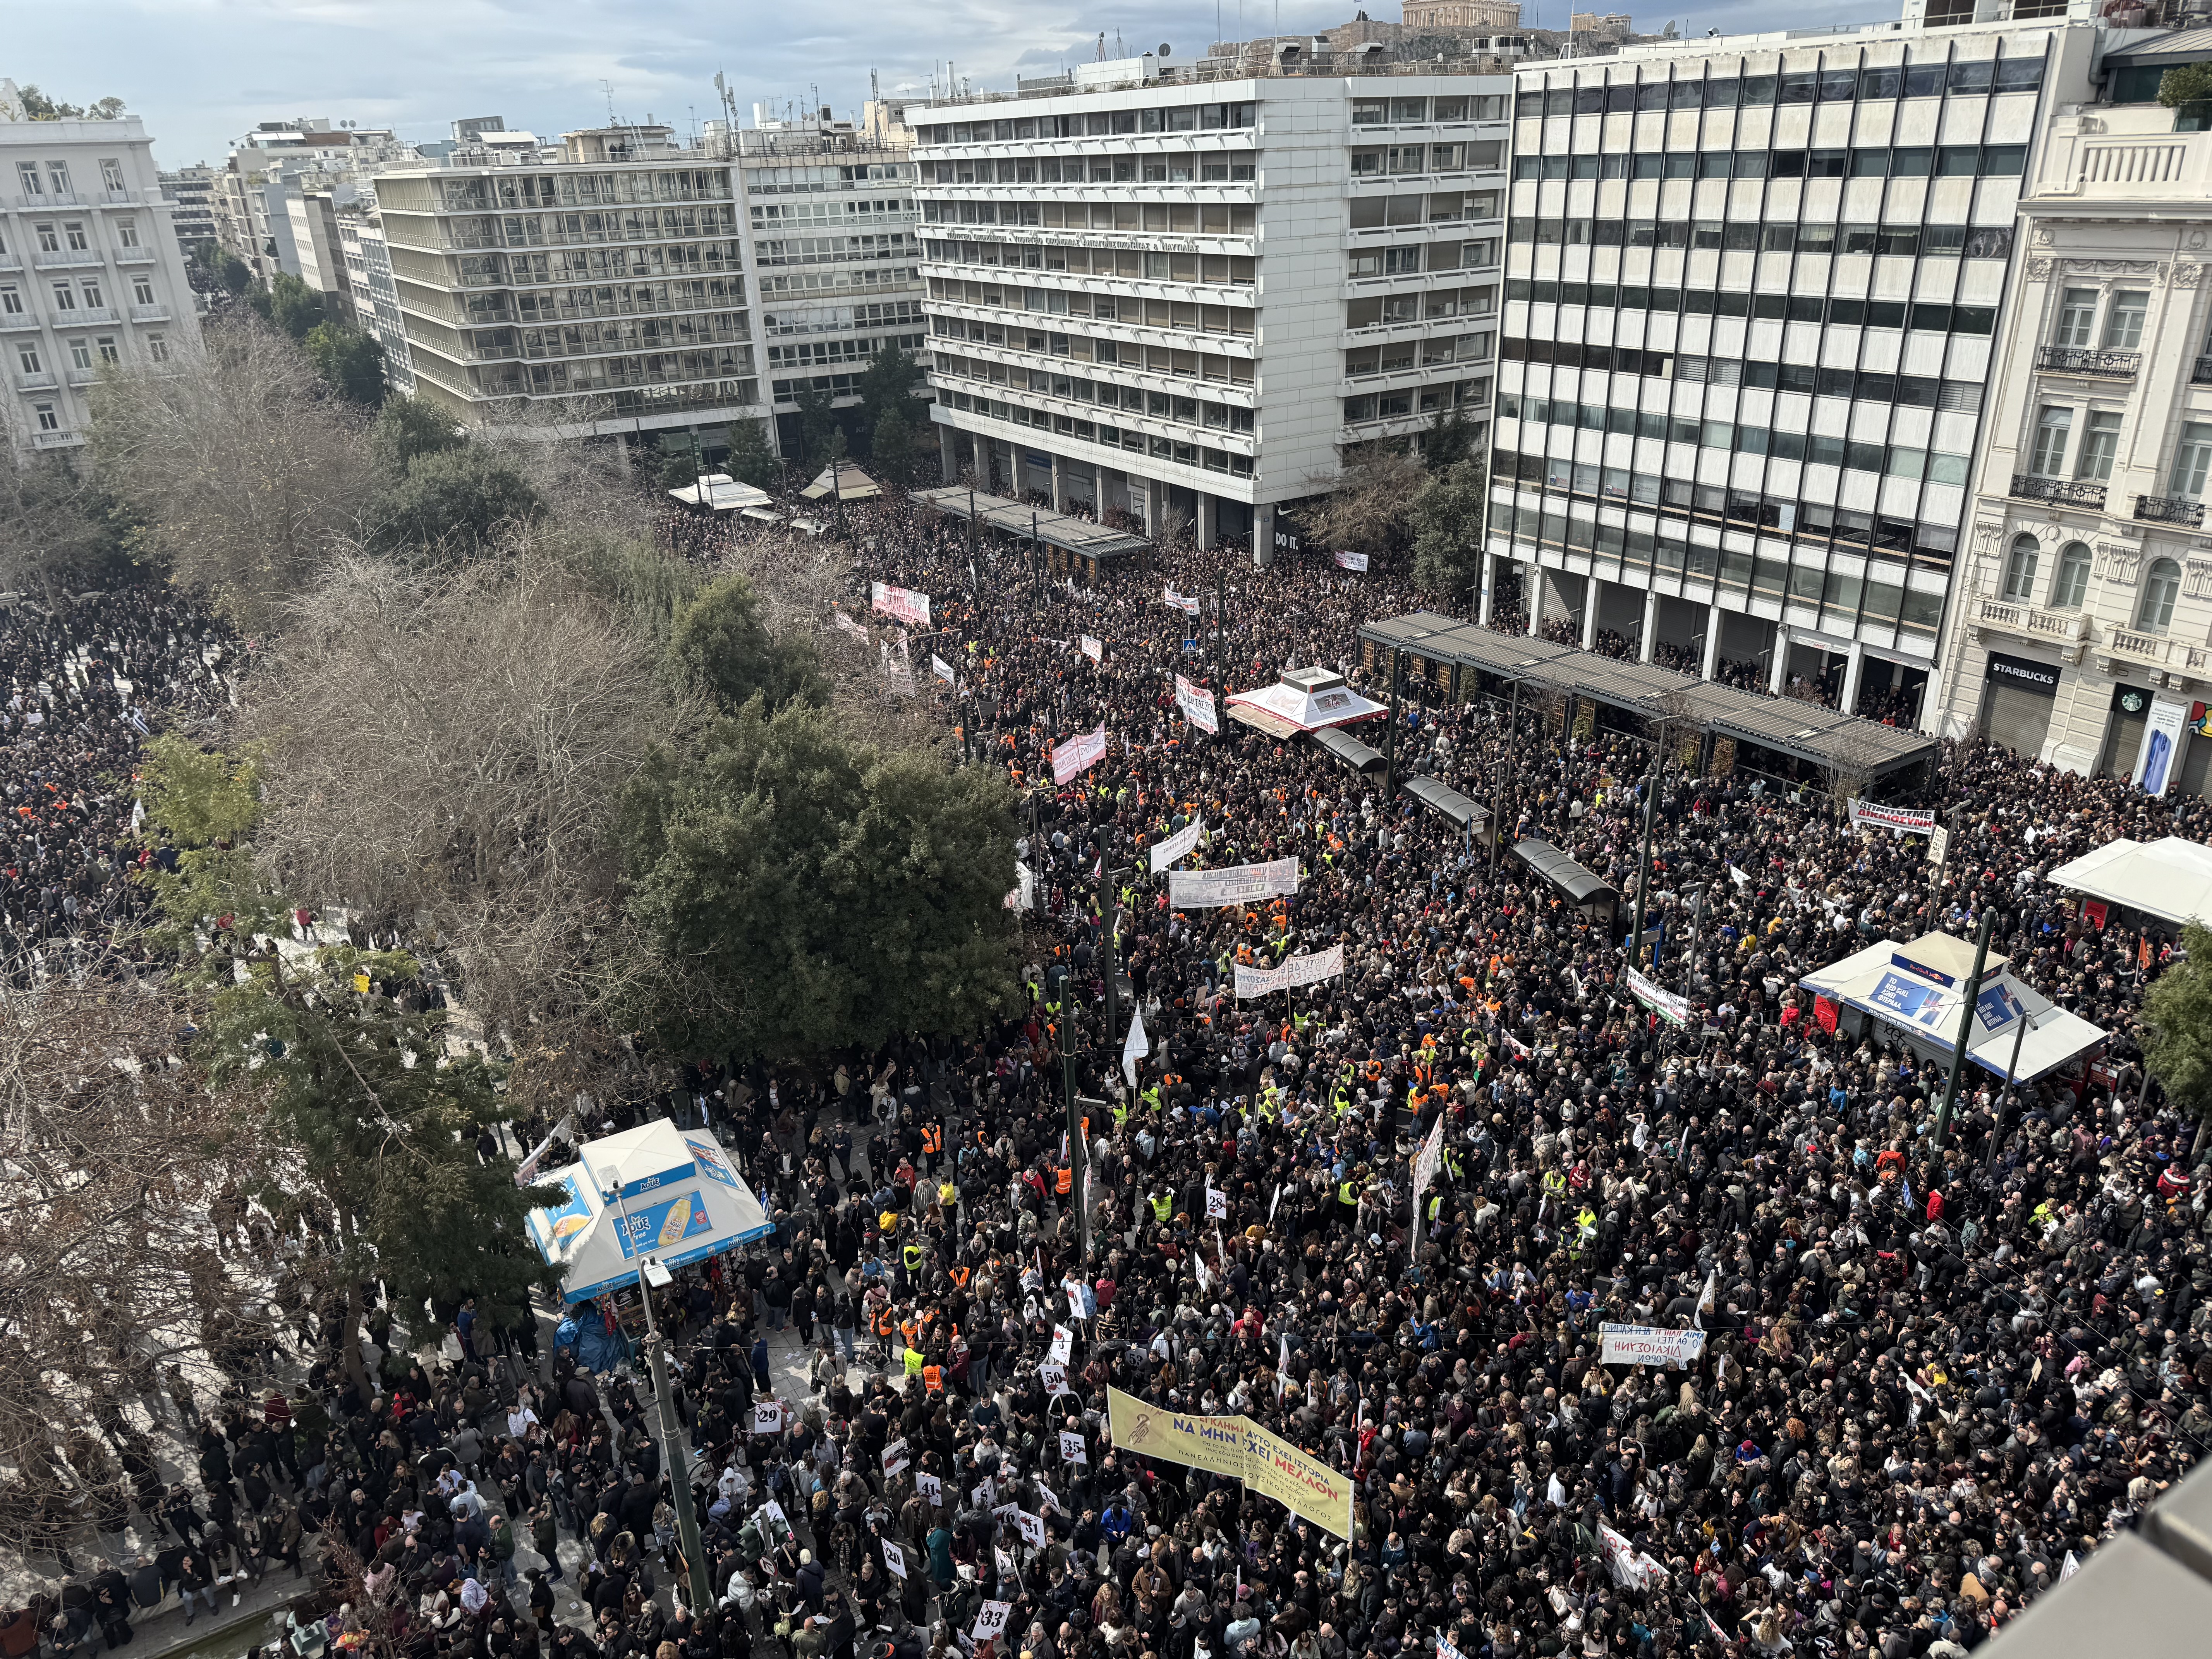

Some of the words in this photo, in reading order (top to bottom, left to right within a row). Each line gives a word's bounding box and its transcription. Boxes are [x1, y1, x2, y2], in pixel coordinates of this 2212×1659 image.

[1014, 236, 1043, 244] ΥΠΟΥΡΓΕΙΟ
[1046, 237, 1080, 246] ΟΙΚΟΝΟΜΙΑΣ
[1084, 239, 1150, 251] ΑΝΤΑΓΩΝΙΣΤΙΚΟΤΗΤΑΣ
[1162, 242, 1200, 253] ΝΑΥΤΙΛΙΑΣ
[1276, 532, 1287, 547] DO
[1289, 536, 1298, 550] IT.
[1993, 663, 2054, 684] STARBUCKS
[1857, 809, 1932, 828] ΔΙΚΑΙΟΣΥΝΗ
[1859, 802, 1932, 819] ΑΠΑΙΤΟΥΜΕ
[1884, 983, 1896, 992] RED
[1896, 987, 1909, 998] BULL
[1627, 980, 1667, 1009] Δικαιοσύνη
[1670, 1006, 1686, 1021] τώρα
[1978, 1005, 1986, 1014] RED
[1985, 1002, 1994, 1011] BULL
[1209, 1196, 1222, 1209] 28
[1129, 1353, 1144, 1365] 53
[1046, 1371, 1062, 1384] 50
[759, 1409, 777, 1423] 29
[1064, 1439, 1080, 1453] 35
[1199, 1417, 1244, 1433] ΕΓΚΛΗΜΑ
[1246, 1430, 1271, 1447] ΑΥΤΟ
[1273, 1444, 1291, 1462] ΕΧΕΙ
[1294, 1458, 1329, 1486] ΙΣΤΟΡΙΑ
[1173, 1418, 1195, 1435] ΝΑ
[1200, 1424, 1236, 1444] ΜΗΝ
[1242, 1435, 1271, 1462] ΕΧΕΙ
[1275, 1455, 1338, 1502] ΜΕΛΛΟΝ
[1236, 1449, 1253, 1463] σηδα,
[1290, 1480, 1310, 1495] κέδρος,
[1252, 1463, 1266, 1473] όπου
[1268, 1471, 1278, 1482] βρει
[921, 1482, 934, 1496] 41
[1179, 1450, 1244, 1468] ΠΑΝΕΛΛΗΝΙΟΣ
[1245, 1472, 1284, 1494] ΟΥΣΙΚΟΣ
[1288, 1494, 1331, 1521] ΣΥΛΛΟΓΟΣ
[886, 1549, 901, 1566] 20
[980, 1611, 1003, 1627] 33
